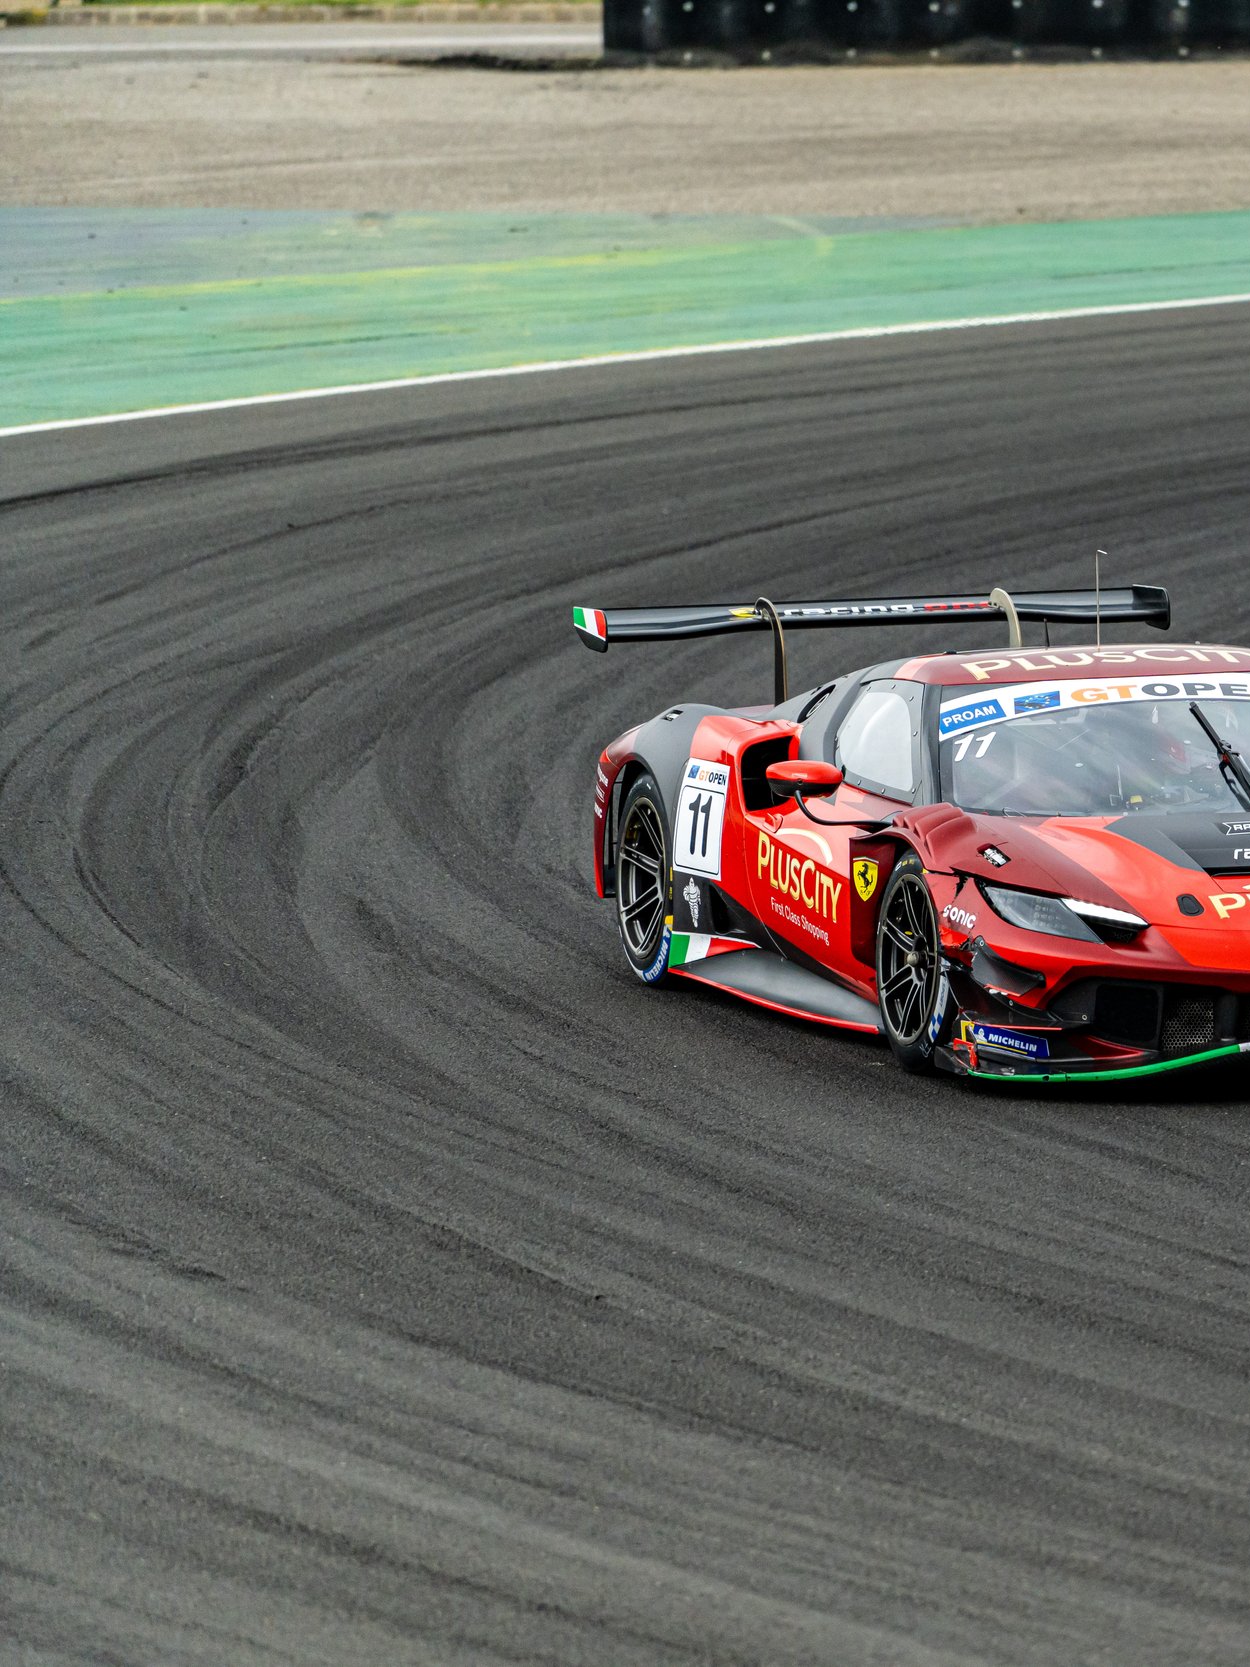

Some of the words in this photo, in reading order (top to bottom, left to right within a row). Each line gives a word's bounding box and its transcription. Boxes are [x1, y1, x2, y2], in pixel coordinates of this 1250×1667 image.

[783, 603, 914, 616] racing
[942, 704, 997, 728] PROAM
[954, 731, 997, 762] 11
[688, 792, 713, 858] 11
[757, 830, 843, 924] PLUSCITY
[770, 896, 785, 917] First
[784, 905, 801, 927] Class
[988, 1032, 1038, 1052] MICHELIN
